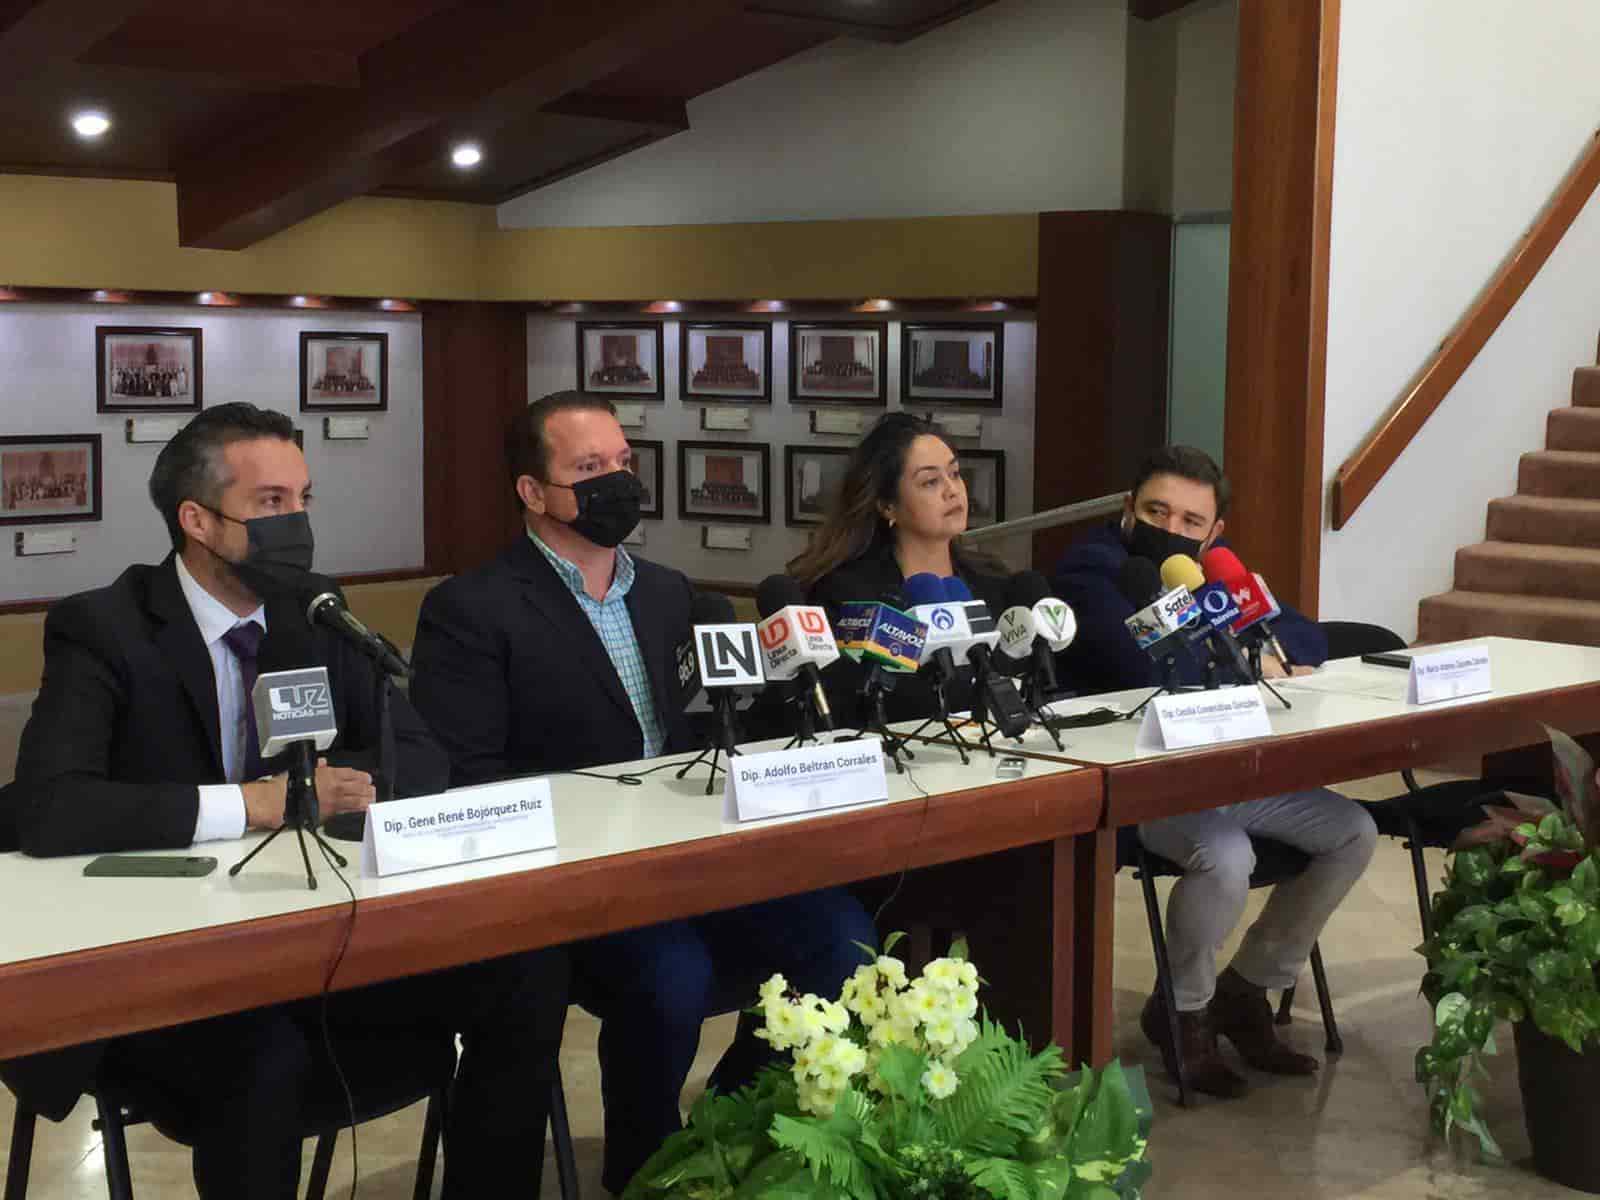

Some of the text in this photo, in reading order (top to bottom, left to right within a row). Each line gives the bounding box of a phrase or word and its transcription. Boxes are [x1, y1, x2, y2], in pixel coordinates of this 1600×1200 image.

[878, 622, 925, 649] ALTAVOZ
[701, 630, 757, 678] LN
[741, 770, 763, 782] Dip.
[764, 764, 797, 778] Adolfo
[837, 753, 877, 768] Corrales
[384, 819, 406, 833] Dip.
[409, 815, 435, 829] Gene
[438, 809, 465, 824] René
[520, 796, 542, 811] Ruiz
